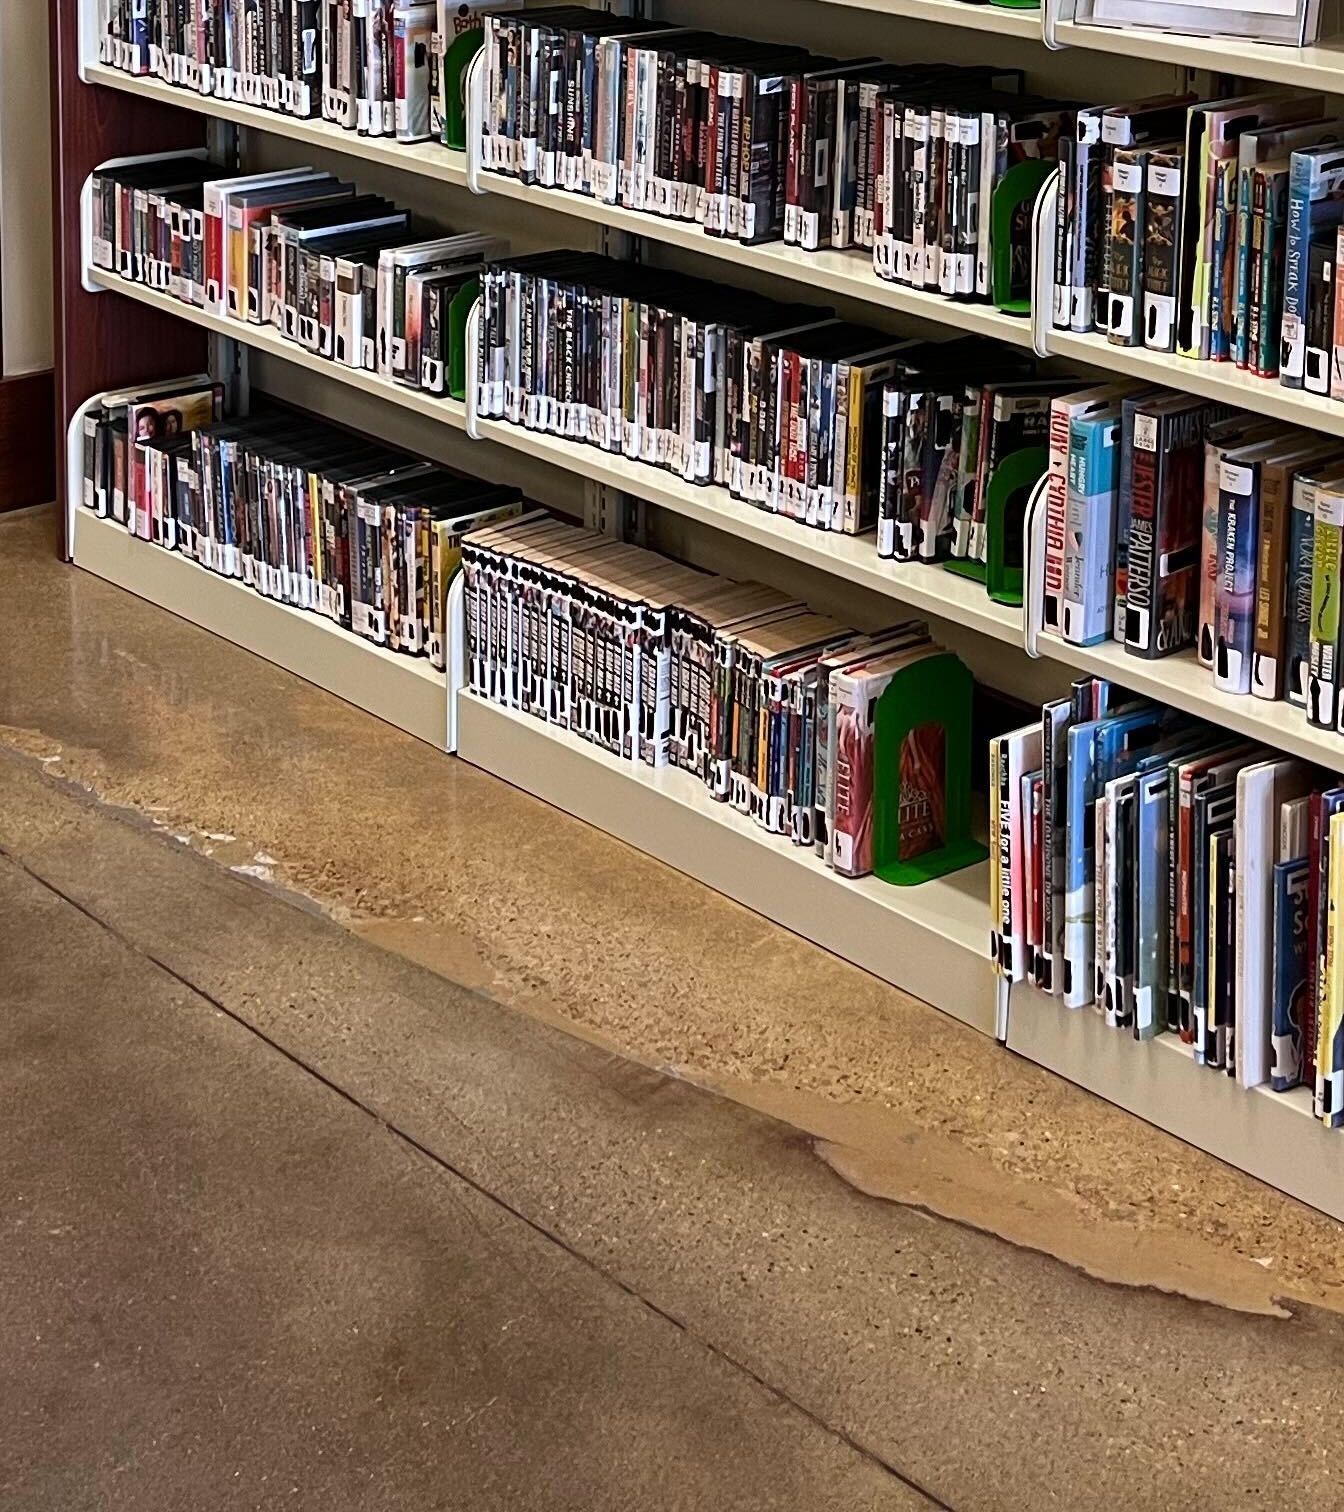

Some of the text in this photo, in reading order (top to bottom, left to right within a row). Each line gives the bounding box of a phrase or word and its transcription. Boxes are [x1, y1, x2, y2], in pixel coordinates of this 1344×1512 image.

[1046, 472, 1066, 551] CYNTHIA
[1077, 456, 1086, 495] HUNGRY
[1132, 462, 1155, 520] JESTER
[1127, 529, 1152, 607] PATTERSO
[1223, 512, 1237, 592] KRAKEN PROJECT
[1321, 644, 1334, 680] WALTER
[999, 800, 1013, 924] FIVE for a little one
